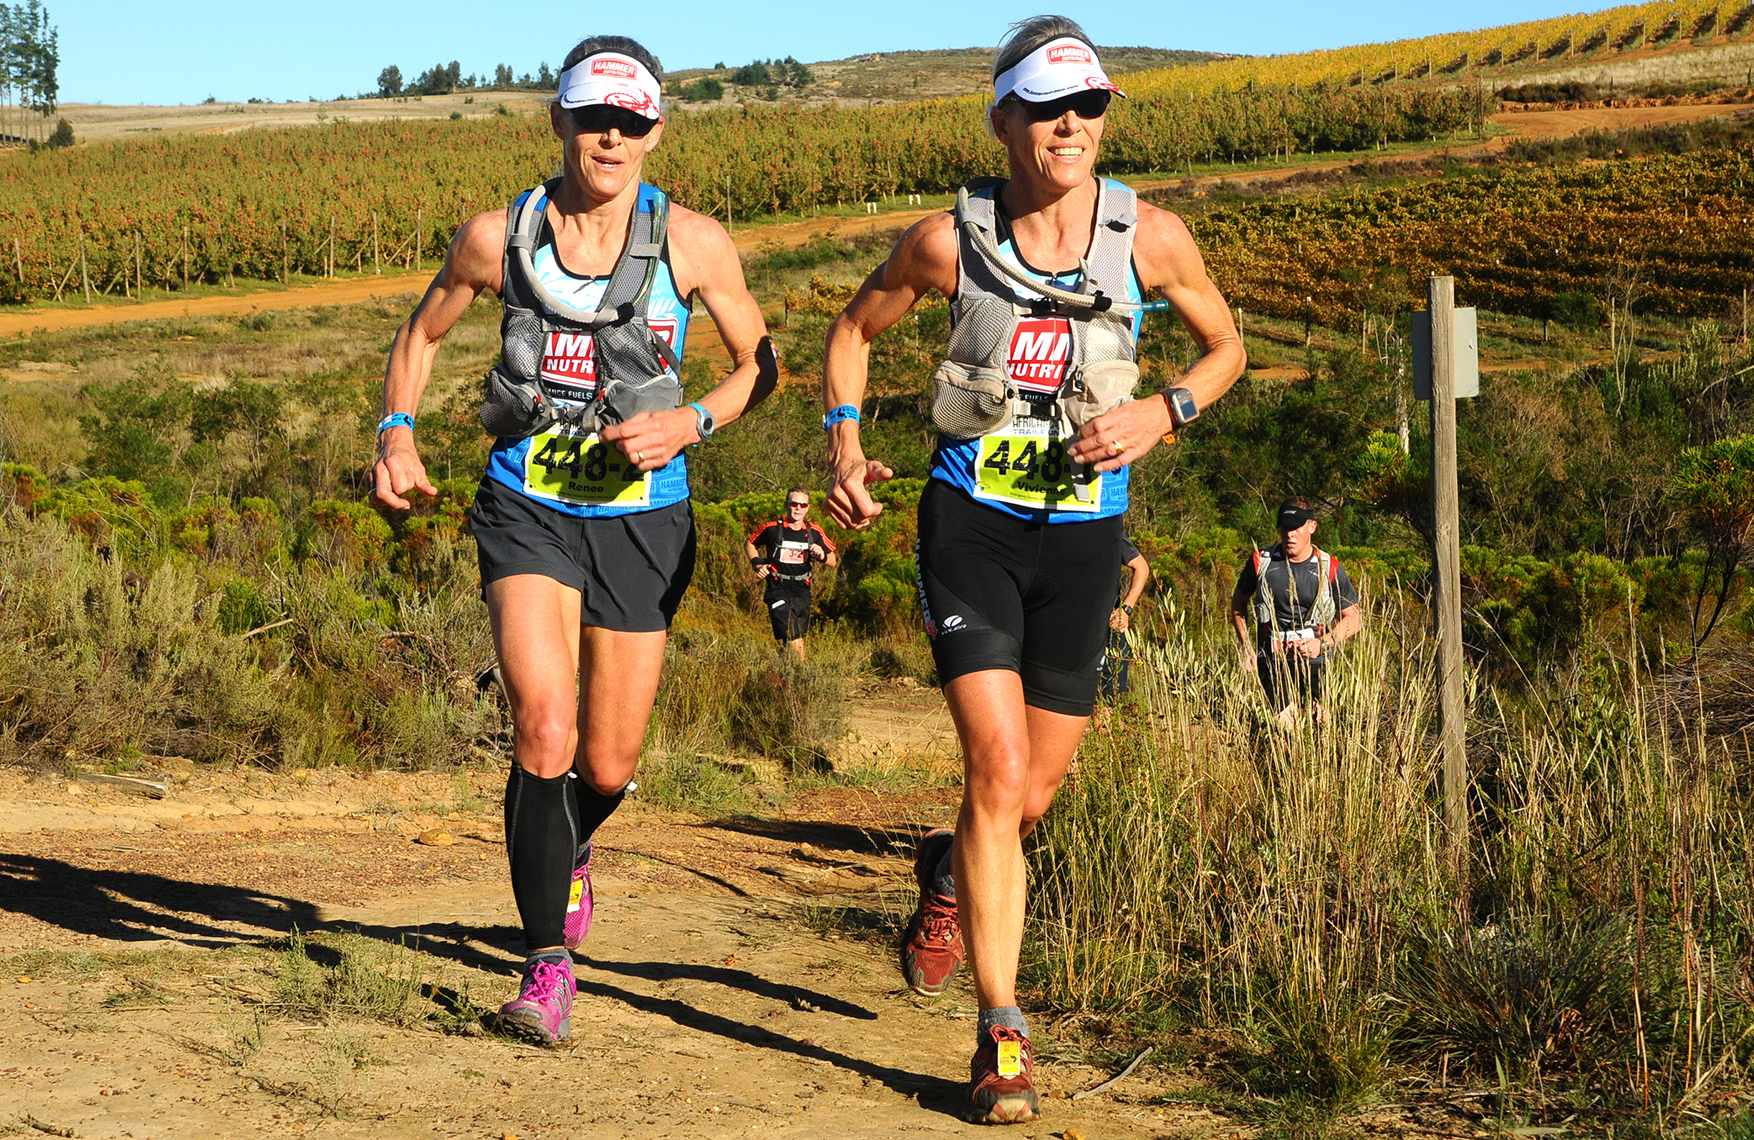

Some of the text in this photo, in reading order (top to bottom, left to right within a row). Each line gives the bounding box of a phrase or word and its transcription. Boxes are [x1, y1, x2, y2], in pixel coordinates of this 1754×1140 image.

[1050, 48, 1089, 58] HAMMER
[594, 61, 635, 75] HAMMER
[568, 390, 593, 400] FUELS
[568, 481, 604, 493] Renee
[1017, 481, 1066, 496] Vivienne
